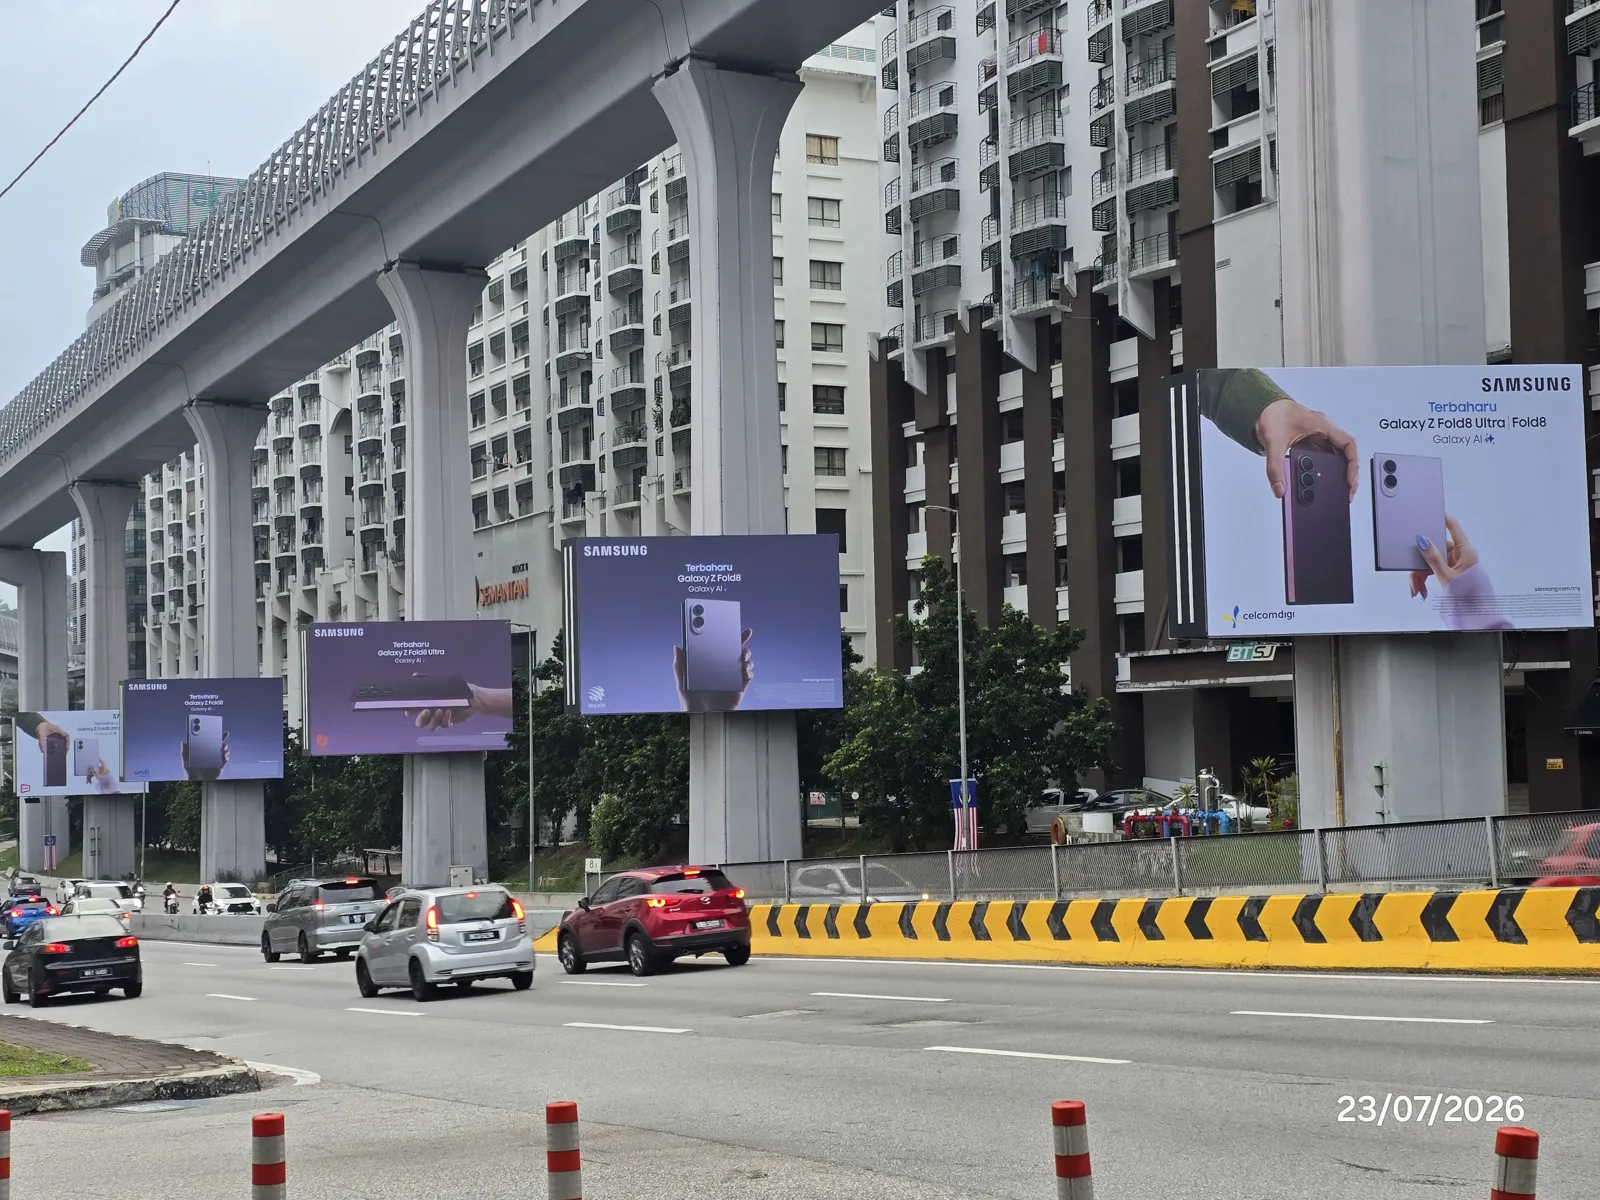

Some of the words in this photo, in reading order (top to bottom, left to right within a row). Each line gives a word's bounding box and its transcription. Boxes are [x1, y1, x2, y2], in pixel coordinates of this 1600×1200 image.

[1481, 376, 1571, 392] SAMSUNG
[1428, 401, 1497, 412] Terbaharu
[1379, 418, 1426, 431] Galaxy
[1427, 418, 1435, 429] Z
[1437, 417, 1473, 429] Fold8
[1475, 417, 1506, 429] Ultra
[1512, 416, 1547, 428] Fold8
[1432, 434, 1471, 446] Galaxy
[1473, 434, 1483, 444] AI
[583, 545, 648, 557] SAMSUNG
[685, 563, 733, 572] Terbaharu
[677, 575, 711, 585] Galaxy
[710, 575, 716, 583] Z
[717, 574, 742, 582] Fold8
[480, 577, 529, 607] SEMANTAN
[688, 585, 715, 593] Galaxy
[1243, 610, 1295, 620] celcomdigi
[314, 628, 364, 637] SAMSUNG
[428, 648, 445, 656] Ultra
